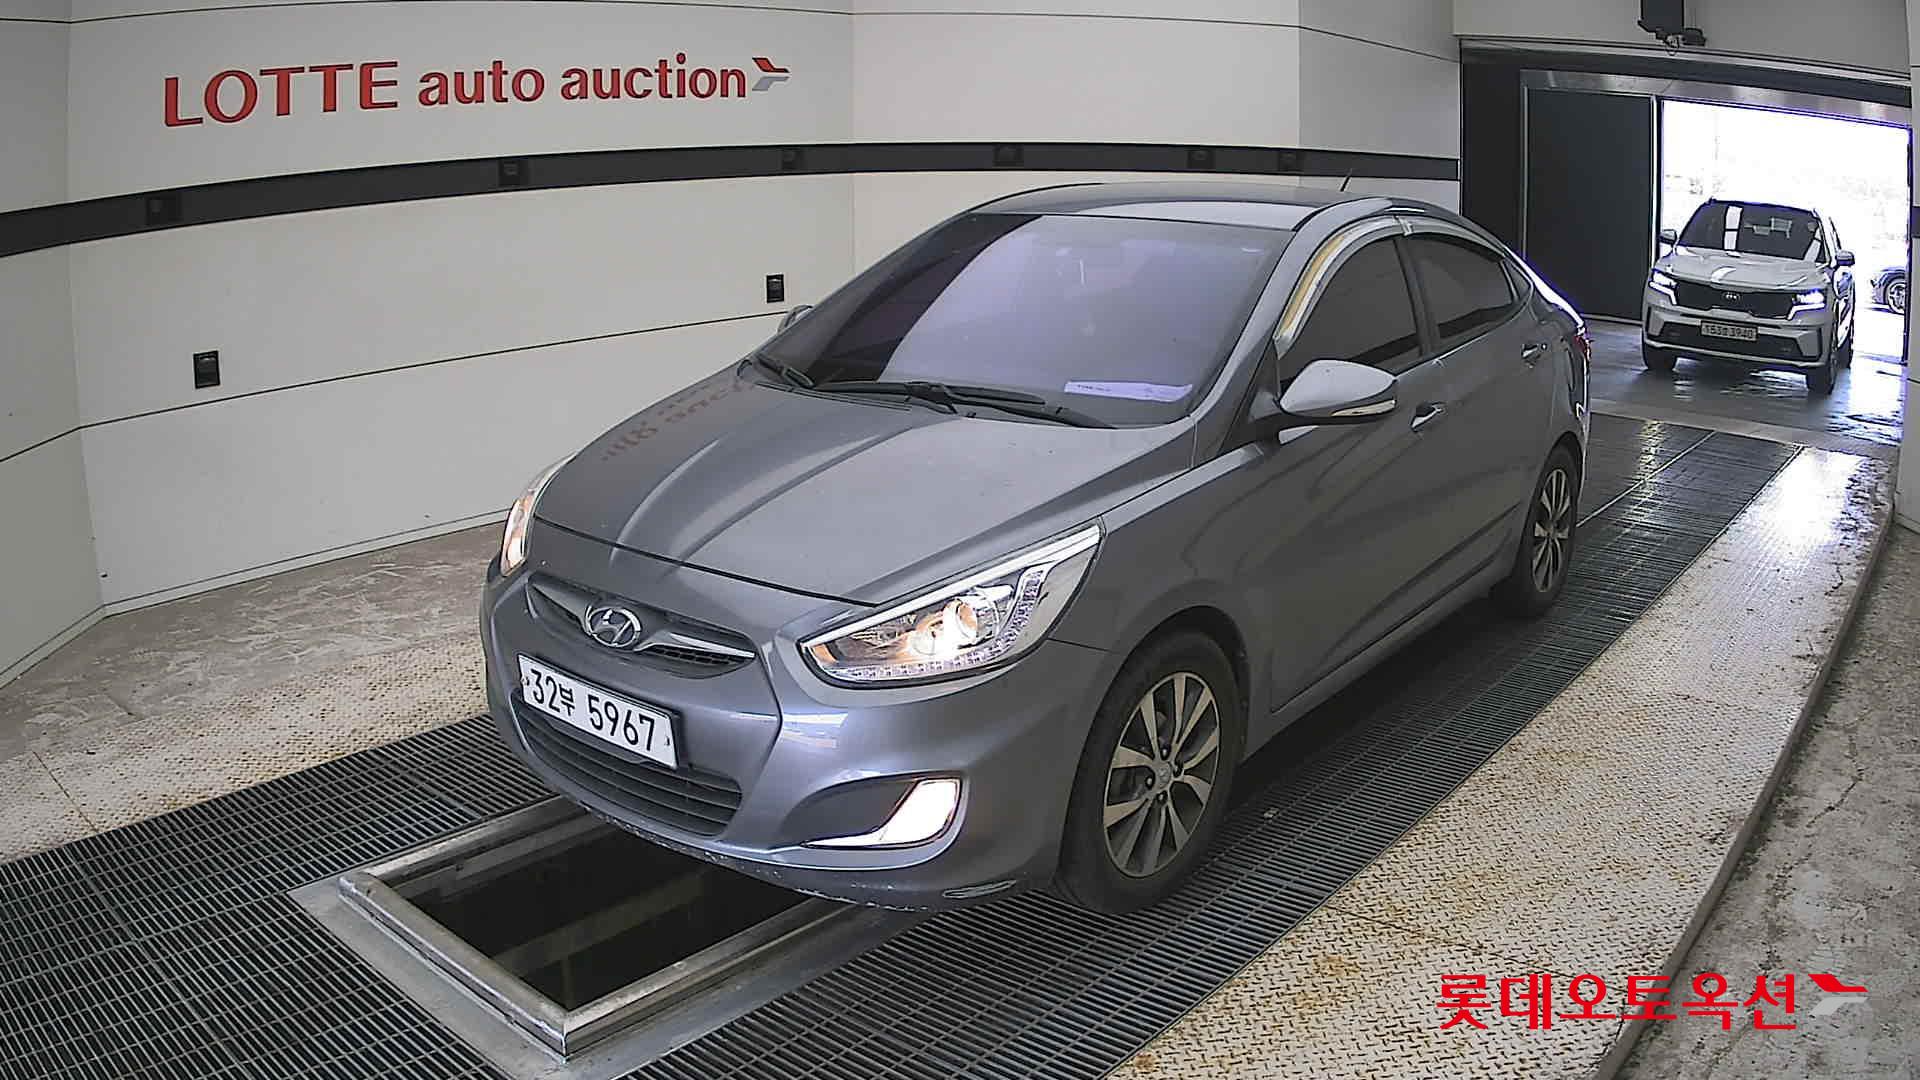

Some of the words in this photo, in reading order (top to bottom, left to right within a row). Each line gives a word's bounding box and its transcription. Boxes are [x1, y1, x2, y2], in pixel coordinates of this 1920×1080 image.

[164, 60, 398, 127] LOTTE
[417, 59, 545, 106] auto
[560, 52, 747, 100] auction
[530, 668, 576, 717] 32부
[587, 694, 655, 752] 5967
